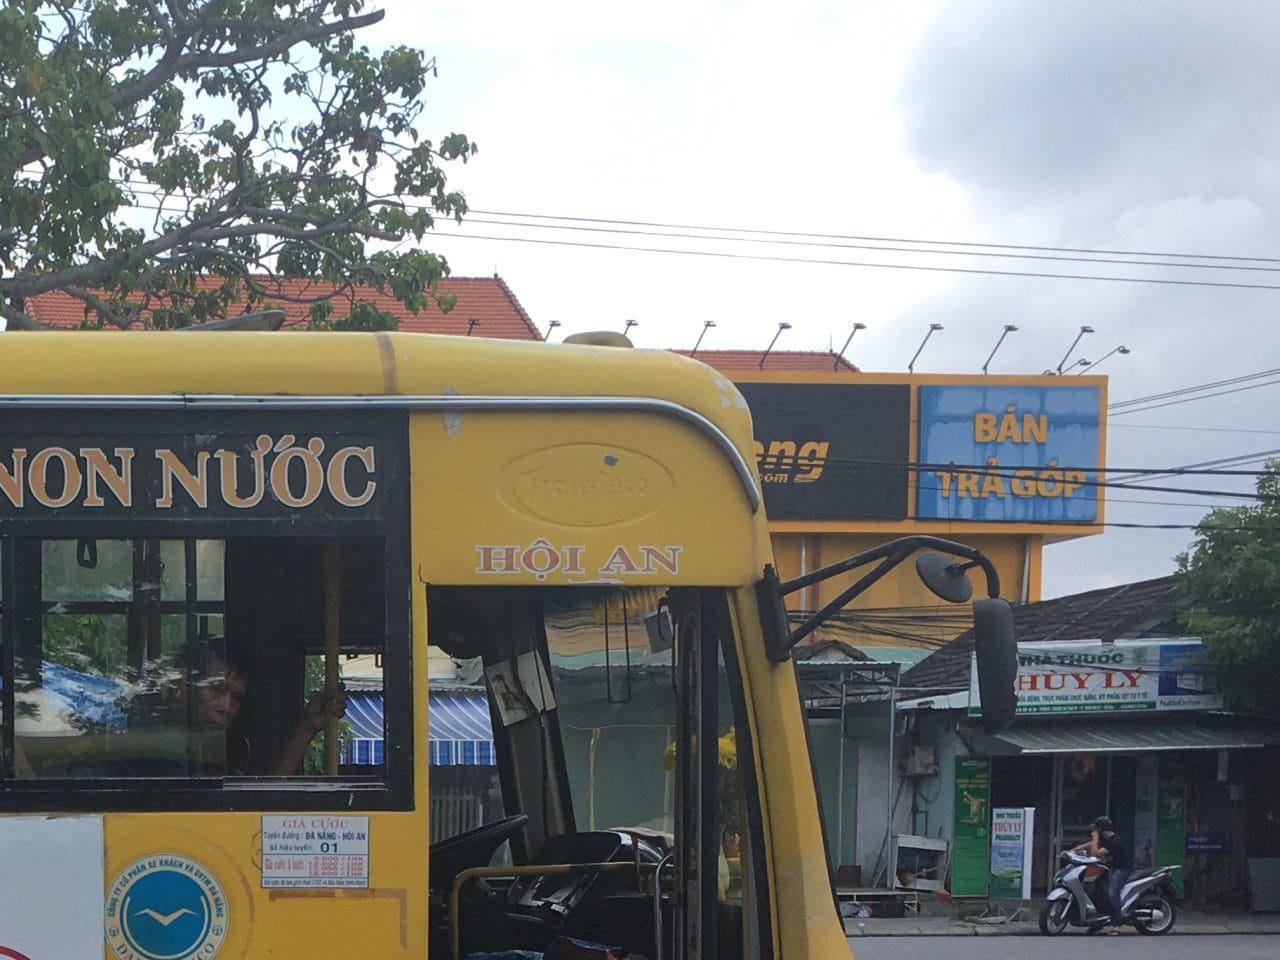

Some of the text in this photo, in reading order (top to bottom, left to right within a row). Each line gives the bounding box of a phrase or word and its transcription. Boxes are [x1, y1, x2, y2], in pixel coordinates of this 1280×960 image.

[975, 405, 1048, 443] BÁN
[155, 433, 377, 509] NƯỚC
[935, 455, 1086, 498] TRẢ GÓP
[475, 537, 684, 580] HỘI AN
[1019, 667, 1144, 691] HÙY LÝ
[283, 818, 307, 829] GIÁ
[356, 833, 366, 841] AN
[320, 842, 338, 853] 01
